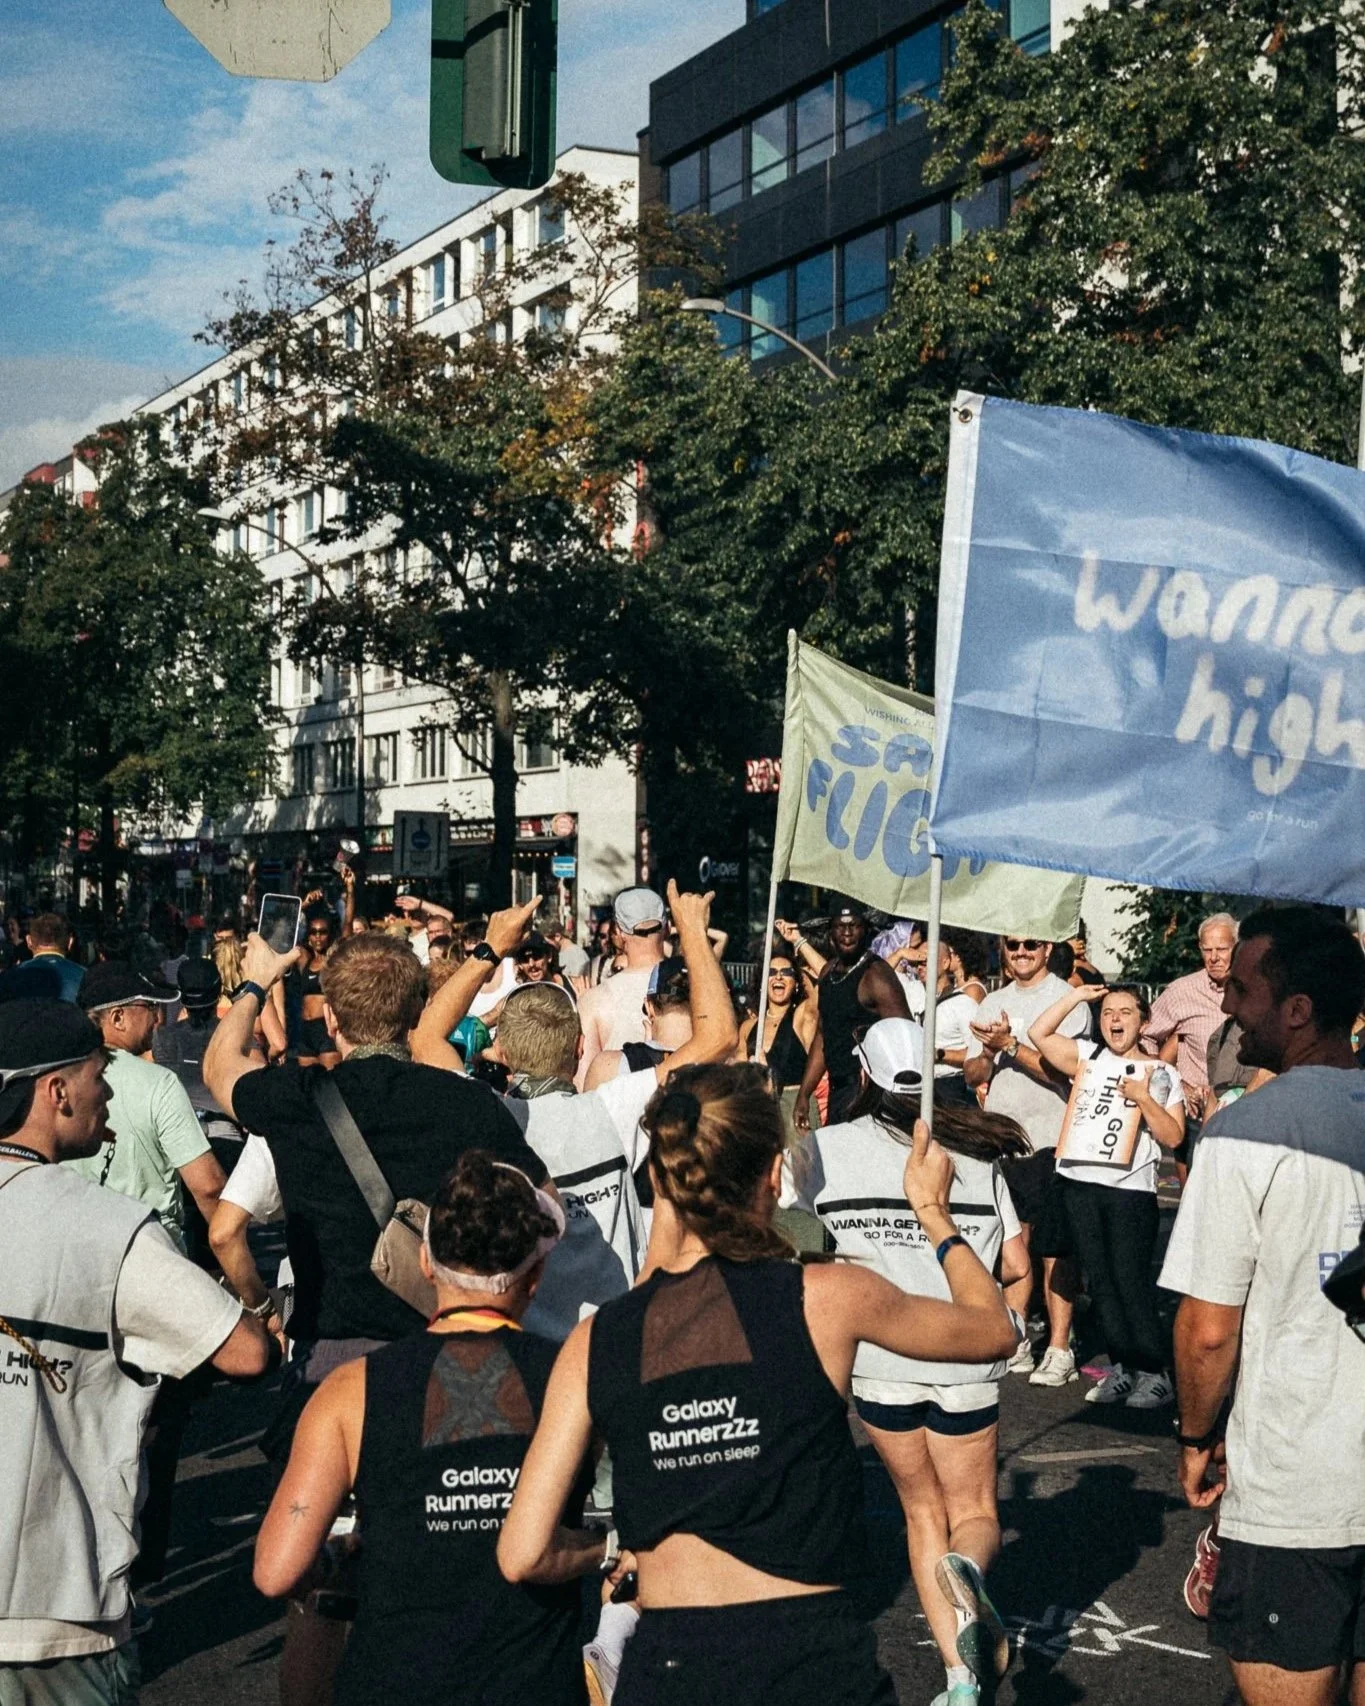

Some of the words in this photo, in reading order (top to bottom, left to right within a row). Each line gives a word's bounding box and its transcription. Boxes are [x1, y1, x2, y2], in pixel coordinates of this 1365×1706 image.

[865, 704, 910, 726] WISHING
[1174, 650, 1365, 796] high
[807, 758, 986, 882] FLIG
[1295, 817, 1319, 830] run
[1089, 1074, 1122, 1120] THIS,
[1098, 1117, 1123, 1160] GOT
[566, 1184, 620, 1209] HIGH?
[566, 1209, 589, 1220] UN
[831, 1217, 892, 1231] WANNA
[893, 1218, 923, 1231] GET
[863, 1230, 881, 1240] GO
[884, 1229, 905, 1240] FOR
[906, 1232, 915, 1242] A
[662, 1396, 738, 1423] Galaxy
[653, 1457, 677, 1471] We
[678, 1453, 702, 1468] run
[703, 1450, 723, 1465] on
[723, 1444, 761, 1462] sleep
[441, 1466, 520, 1489] Galaxy
[425, 1489, 516, 1513] Runnerz
[426, 1519, 450, 1532] We
[452, 1518, 478, 1531] run
[479, 1518, 499, 1530] on
